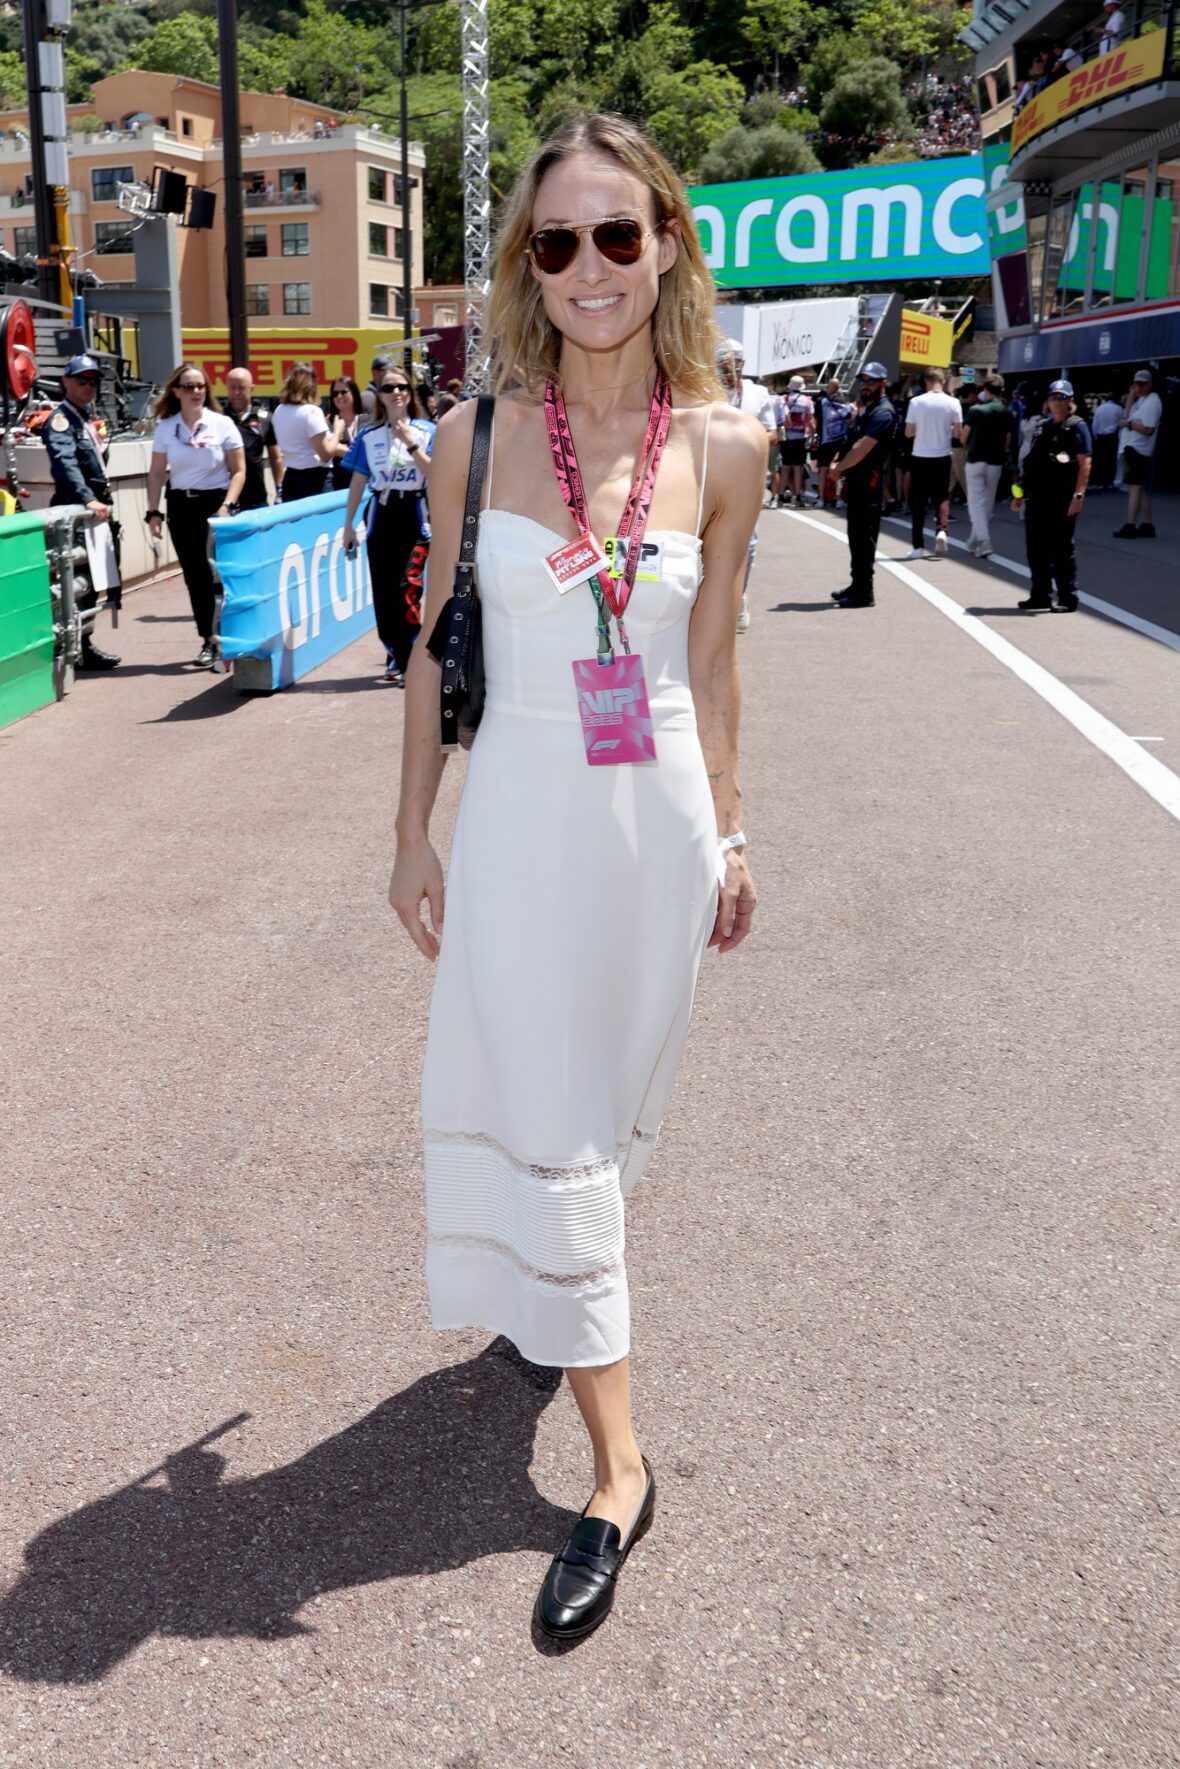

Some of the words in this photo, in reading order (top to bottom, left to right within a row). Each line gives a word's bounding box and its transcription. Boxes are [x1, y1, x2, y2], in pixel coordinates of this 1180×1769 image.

[1067, 51, 1128, 107] DHL
[772, 334, 812, 361] MONACO
[379, 468, 417, 482] VISA
[582, 688, 635, 714] VIP
[582, 713, 622, 728] 2026
